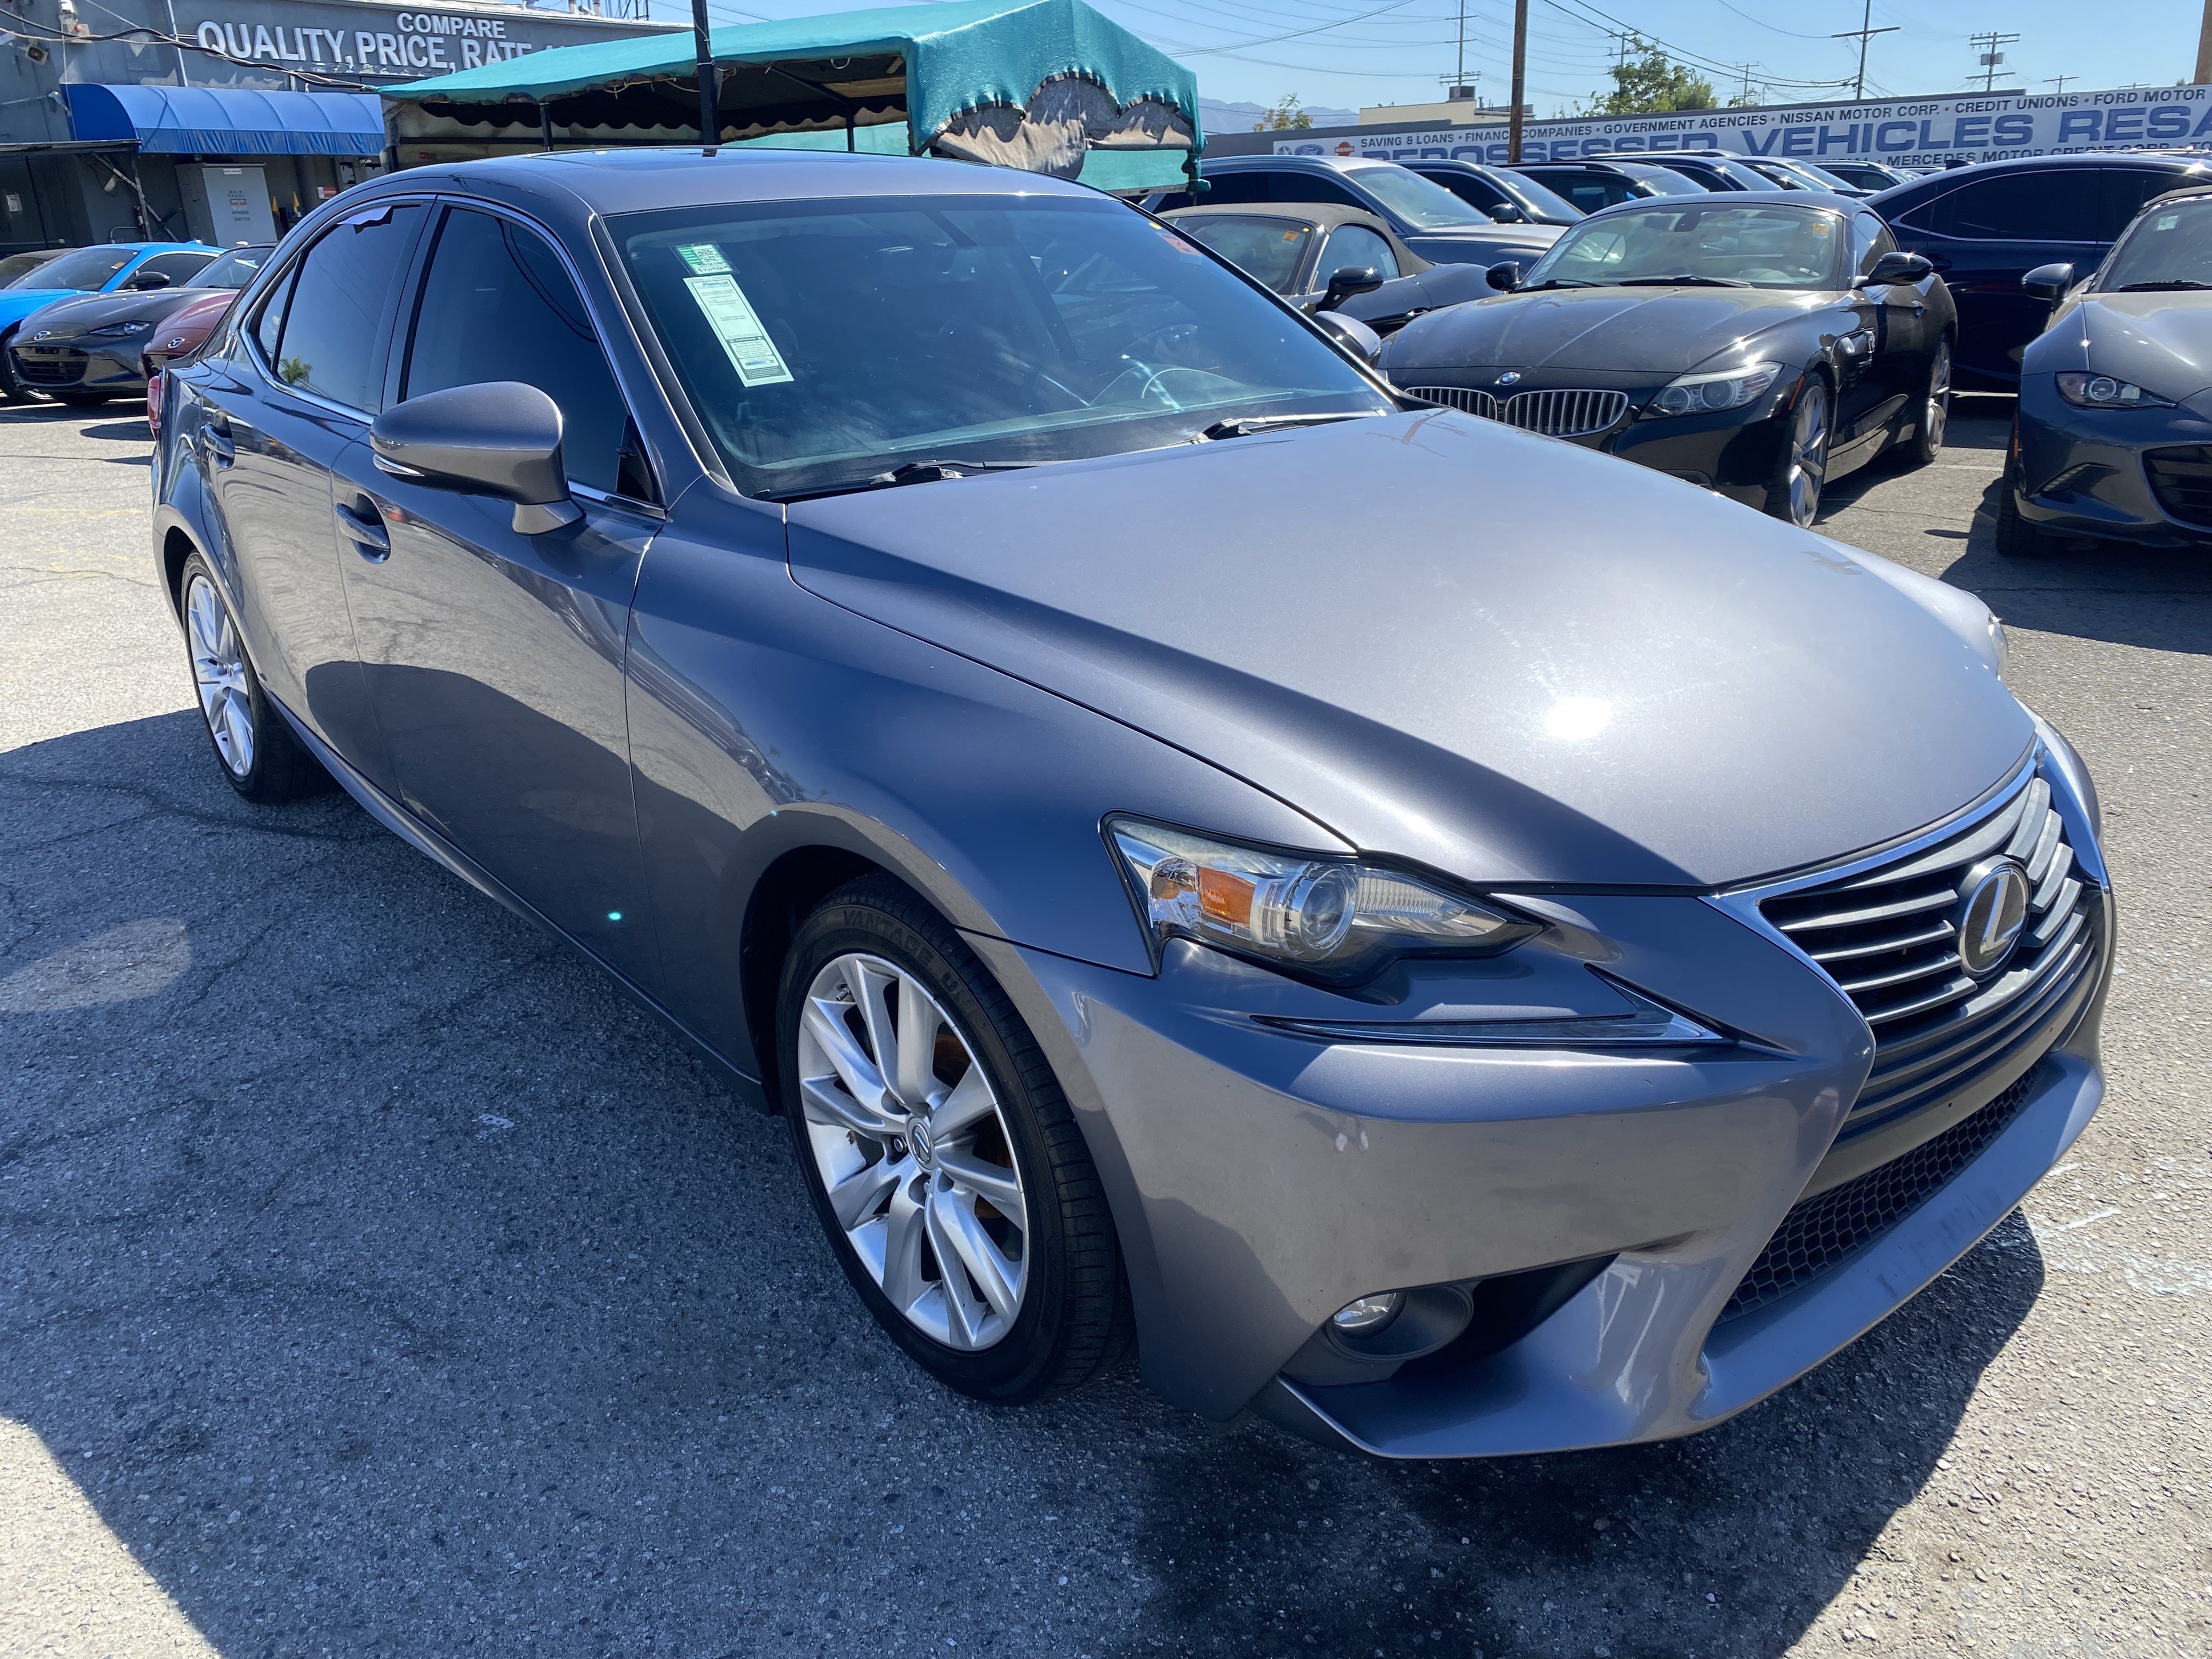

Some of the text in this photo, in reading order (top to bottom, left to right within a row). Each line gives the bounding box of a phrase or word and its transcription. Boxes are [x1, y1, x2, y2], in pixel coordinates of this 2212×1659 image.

[396, 13, 507, 39] COMPARE
[355, 31, 457, 74] PRICE,
[1361, 89, 2206, 148] SAVING & LOANS FINANC COMPANIES GOVERNMENT AGENCIES NISSAN MOTOR CORP. CREDIT UNIONS FORD MOTOR
[1741, 114, 2034, 157] VEHICLES
[843, 910, 933, 968] VANTAGE
